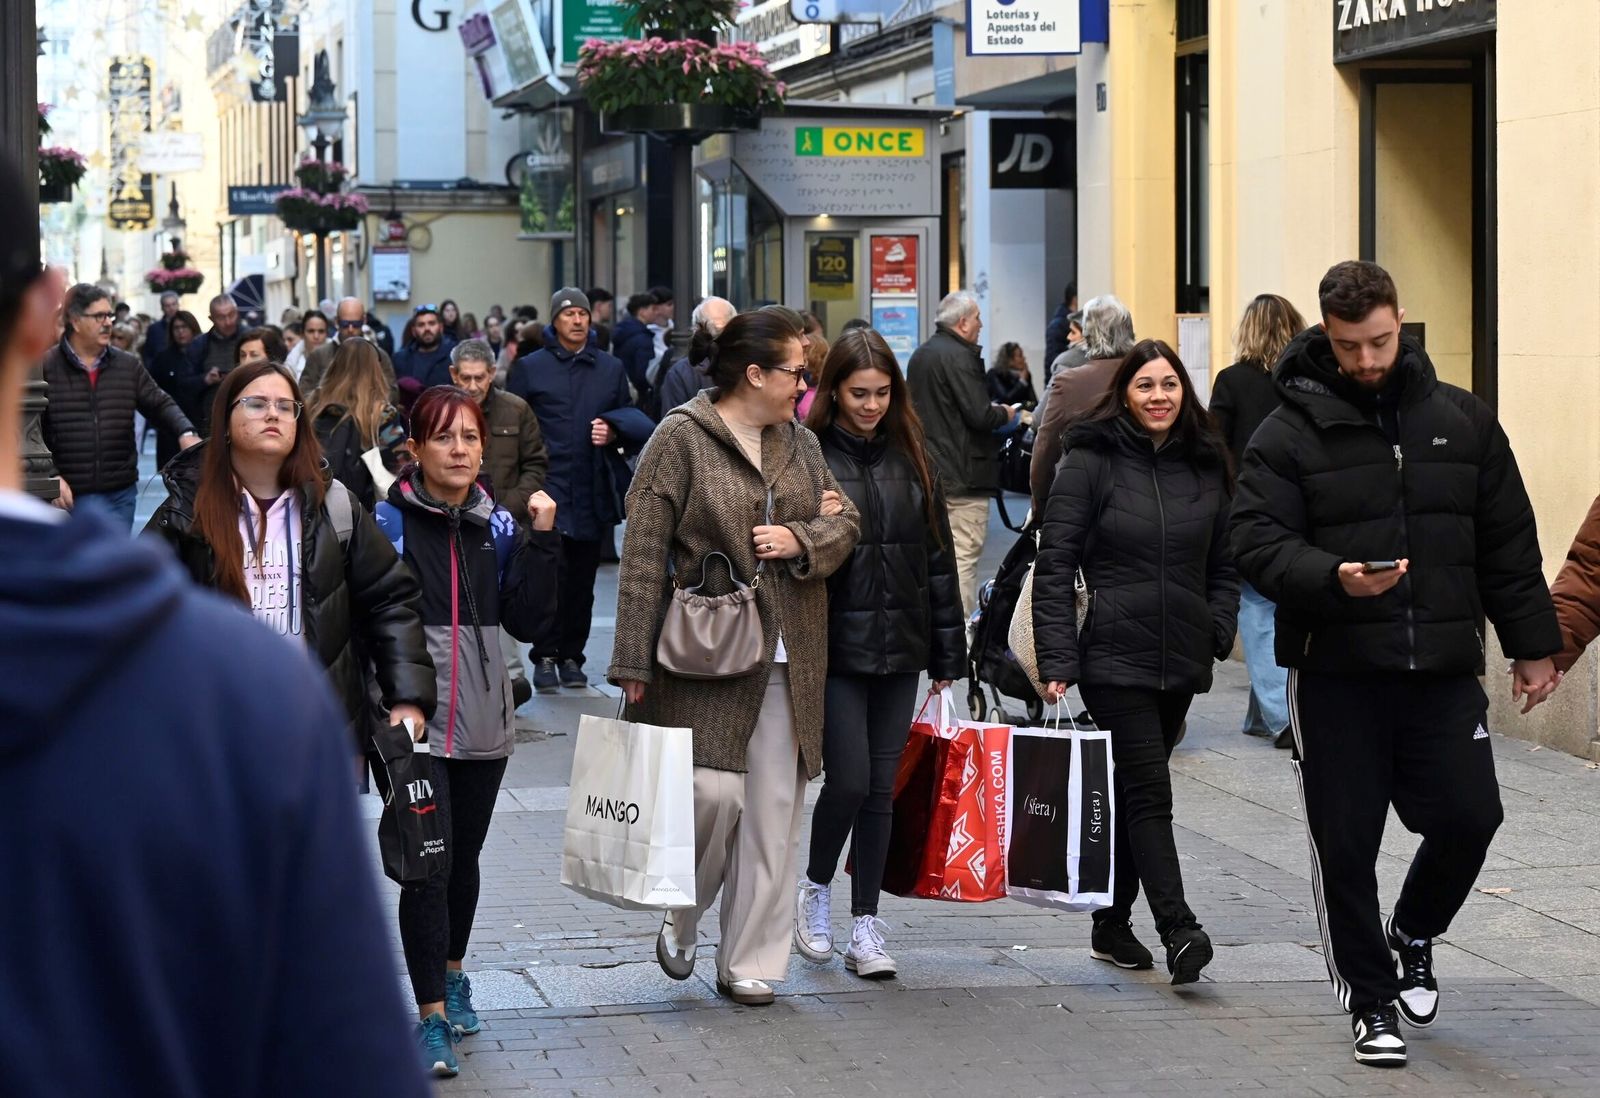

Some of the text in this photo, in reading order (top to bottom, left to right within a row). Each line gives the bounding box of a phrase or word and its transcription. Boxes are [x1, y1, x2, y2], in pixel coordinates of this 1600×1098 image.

[986, 9, 1039, 21] Loterías y
[1338, 0, 1407, 30] ZARA
[987, 22, 1056, 34] Apuestas del
[987, 35, 1024, 45] Estado
[834, 131, 913, 152] ONCE
[997, 133, 1053, 173] JD
[816, 256, 847, 272] 120
[253, 573, 282, 581] MMXIX
[585, 794, 640, 825] MANGO
